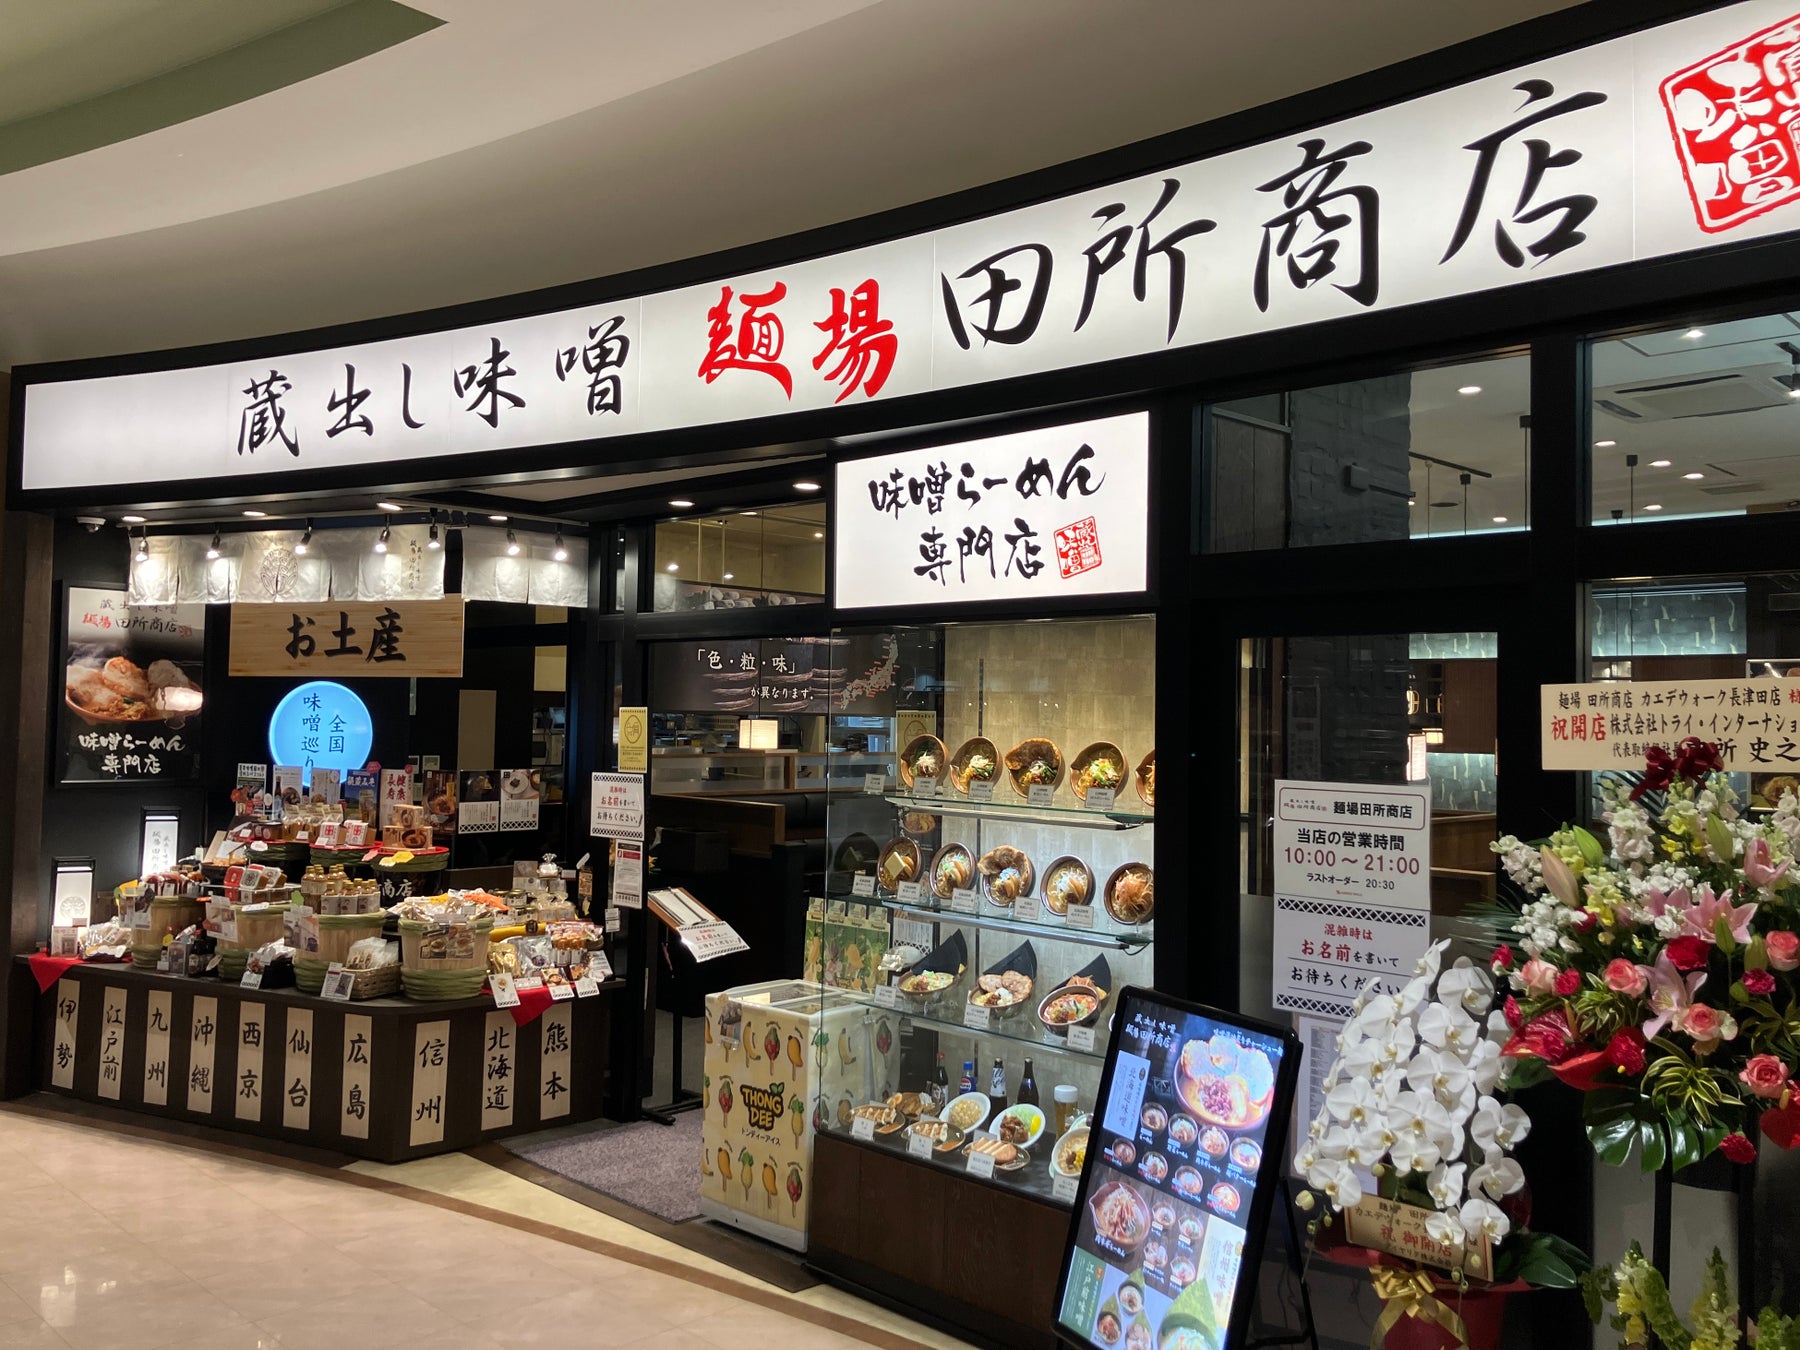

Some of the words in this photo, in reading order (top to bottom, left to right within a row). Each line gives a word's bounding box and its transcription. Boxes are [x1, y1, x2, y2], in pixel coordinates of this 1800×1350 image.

[237, 315, 631, 458] 蔵出し味噌
[697, 279, 898, 404] 麺場
[941, 79, 1608, 349] 田所商店
[868, 443, 1106, 520] 味噌らーめん
[914, 517, 1045, 587] 専門店
[286, 606, 407, 664] お土産
[301, 693, 322, 769] 味噌巡り
[1551, 713, 1606, 742] 祝開店
[1587, 691, 1633, 709] 田所商店
[78, 732, 185, 751] 味噌らーめん
[102, 754, 162, 775] 専門店
[329, 714, 347, 754] 全国
[1297, 828, 1405, 851] 当店の営業時間
[378, 878, 412, 898] 商店
[1306, 873, 1359, 885] ラストオーダー
[1366, 878, 1395, 890] 20:30
[1301, 939, 1400, 968] お名前を書いて
[1324, 923, 1373, 941] 混雑時は
[55, 996, 77, 1067] 伊勢
[101, 1004, 124, 1081] 江戸前
[148, 1007, 169, 1088] 九州
[191, 1017, 215, 1095] 沖縄
[240, 1021, 261, 1098] 西京
[543, 1021, 569, 1100] 熊本
[287, 1027, 311, 1108] 仙台
[346, 1033, 369, 1121] 広島
[415, 1038, 446, 1124] 信州
[485, 1029, 512, 1111] 北海道
[742, 1087, 782, 1114] THONG
[750, 1107, 773, 1127] DEE
[741, 1127, 781, 1146] トンディーアイス
